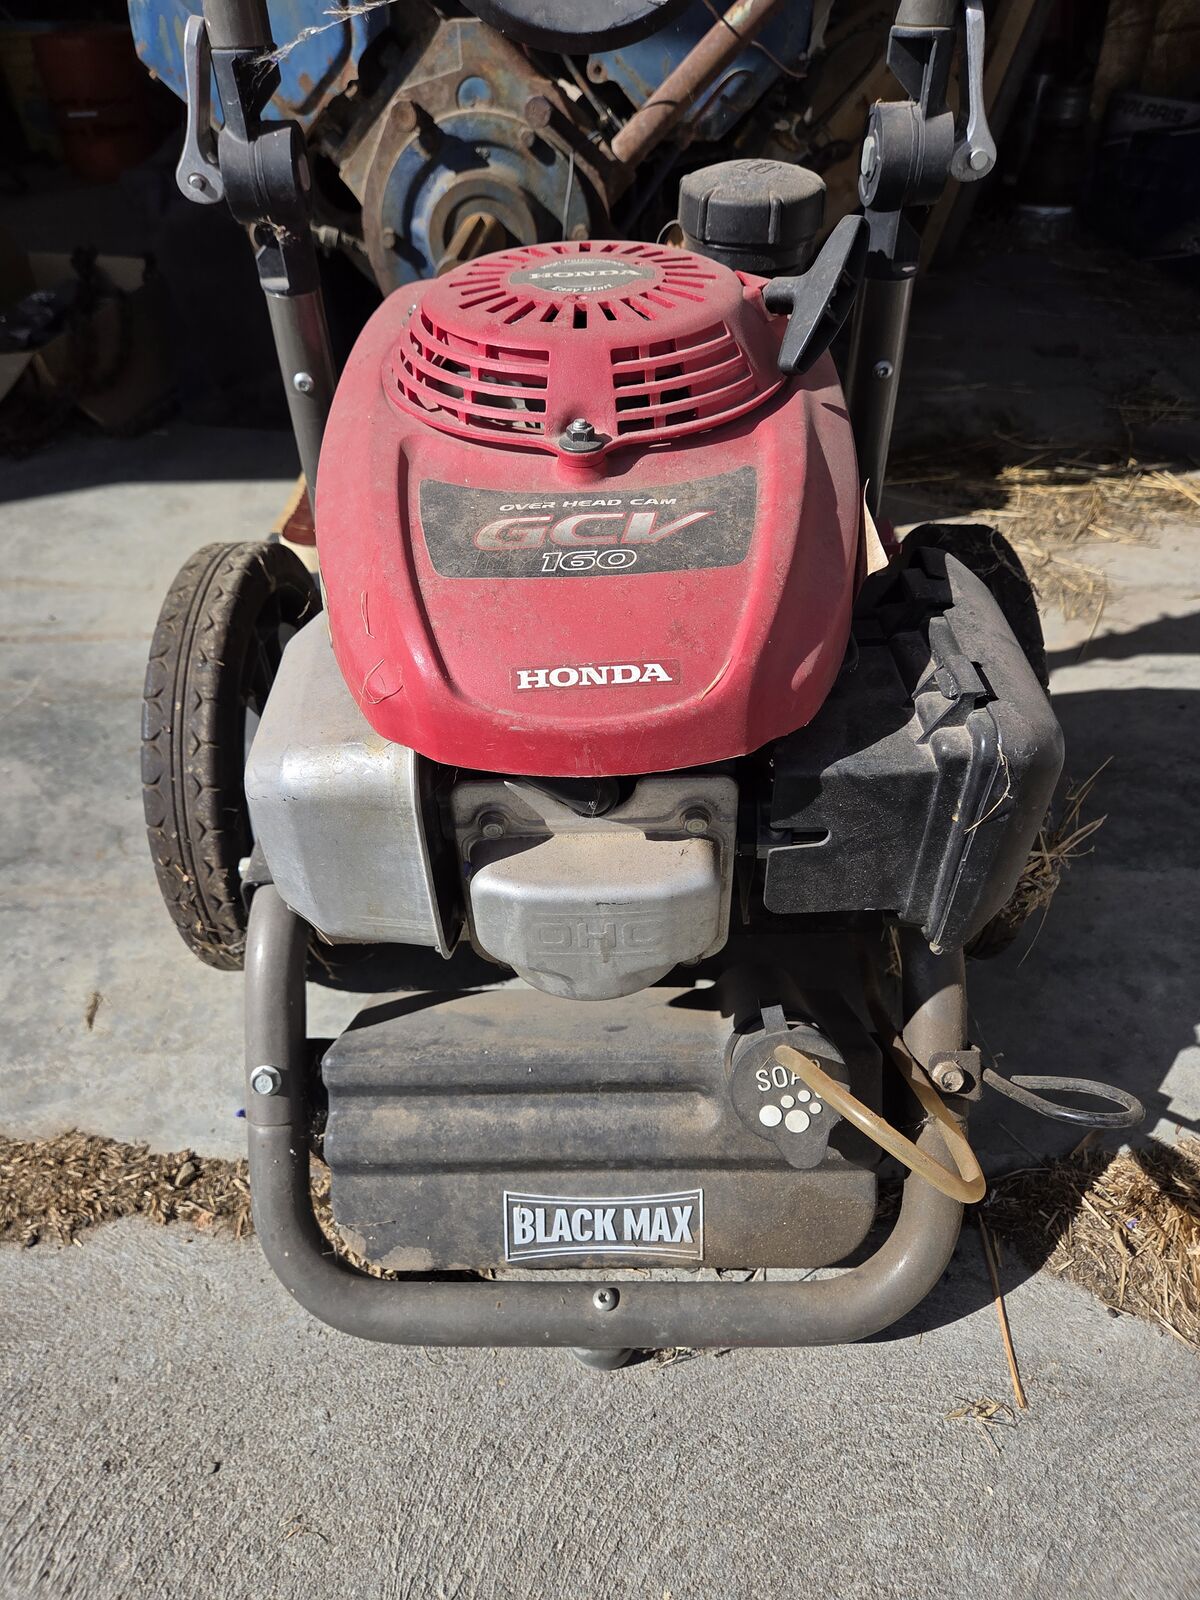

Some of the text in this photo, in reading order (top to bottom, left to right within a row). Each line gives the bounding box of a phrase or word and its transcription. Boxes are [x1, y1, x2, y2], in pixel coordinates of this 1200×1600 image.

[529, 269, 642, 280] HONDA
[499, 498, 677, 511] OVER HEAD CAM
[473, 511, 716, 551] GCV
[541, 549, 637, 572] 160
[516, 663, 673, 690] HONDA
[534, 921, 662, 949] OHC
[513, 1205, 694, 1245] BLACK MAX
